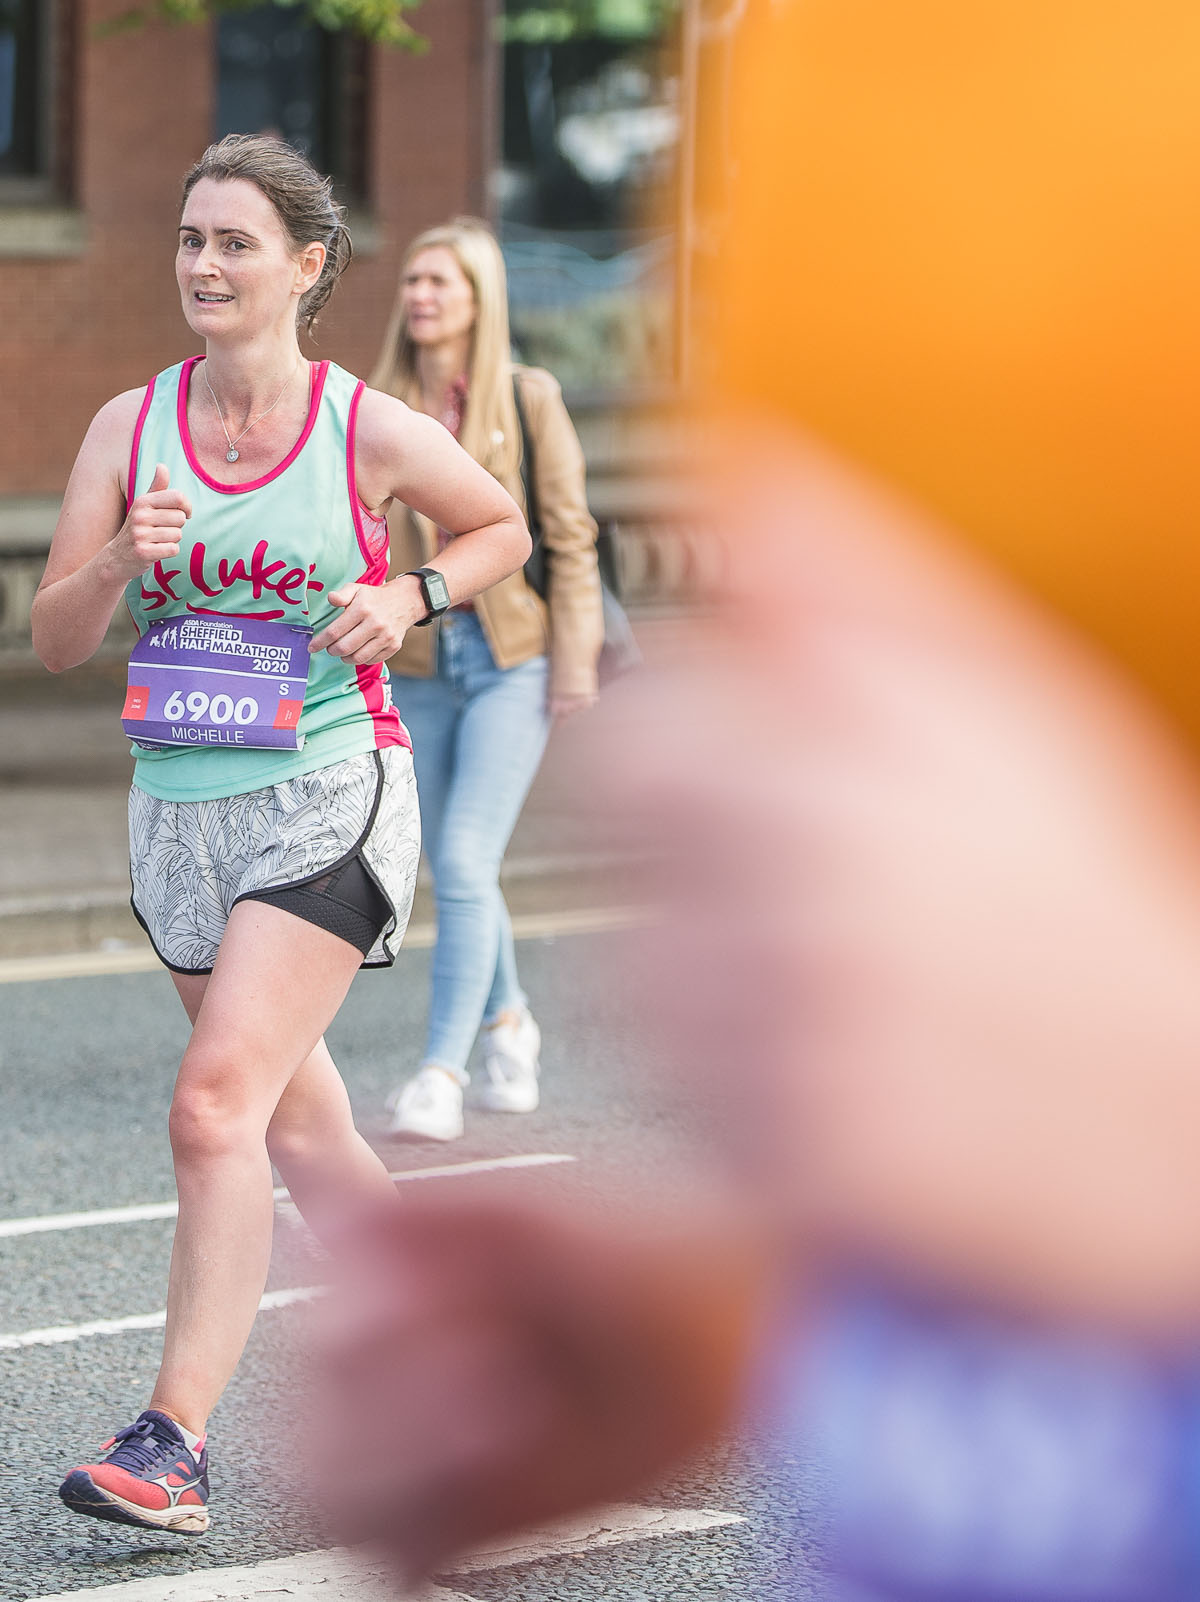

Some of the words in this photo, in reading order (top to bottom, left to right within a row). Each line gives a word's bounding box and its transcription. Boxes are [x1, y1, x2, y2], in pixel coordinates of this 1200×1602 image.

[200, 621, 233, 629] Foundation
[181, 627, 240, 641] SHEFFIELD
[180, 639, 210, 651] HALF
[212, 641, 289, 659] MARATHON
[252, 659, 289, 674] 2020
[279, 683, 289, 696] S
[163, 690, 259, 725] 6900
[171, 727, 244, 744] MICHELLE
